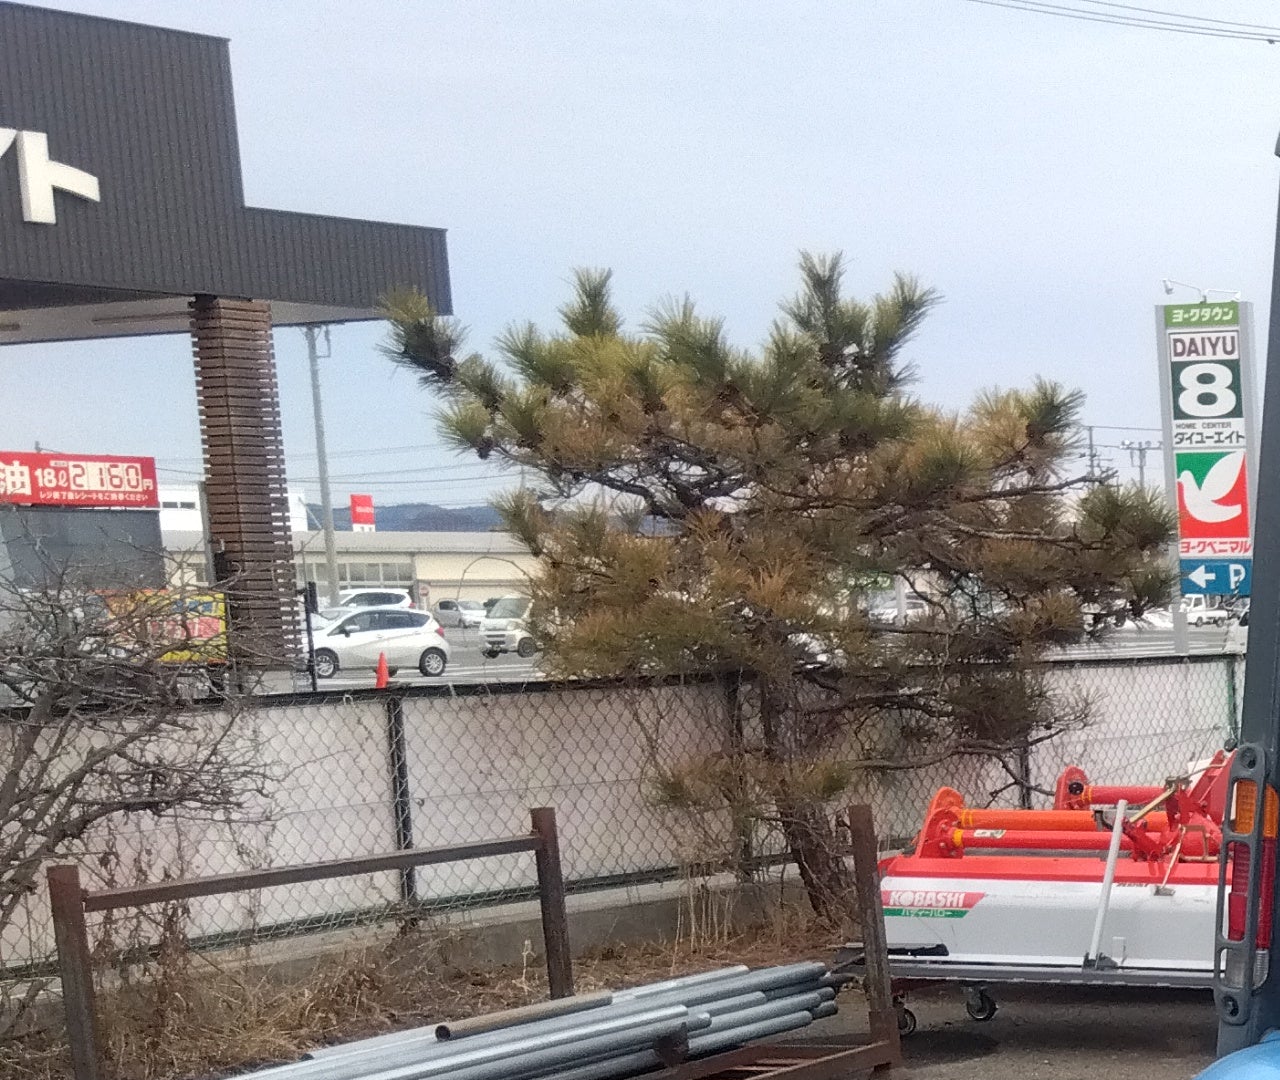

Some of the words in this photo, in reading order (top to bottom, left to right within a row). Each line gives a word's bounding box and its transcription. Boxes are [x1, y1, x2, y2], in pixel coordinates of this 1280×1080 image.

[0, 127, 100, 224] ト
[1172, 307, 1233, 322] ヨークタウン
[1173, 336, 1236, 357] DAIYU
[1178, 363, 1237, 417] 8
[1174, 430, 1245, 445] ダイユーエイト
[1180, 541, 1251, 554] ヨークベニマル
[889, 891, 965, 908] KOBASHI
